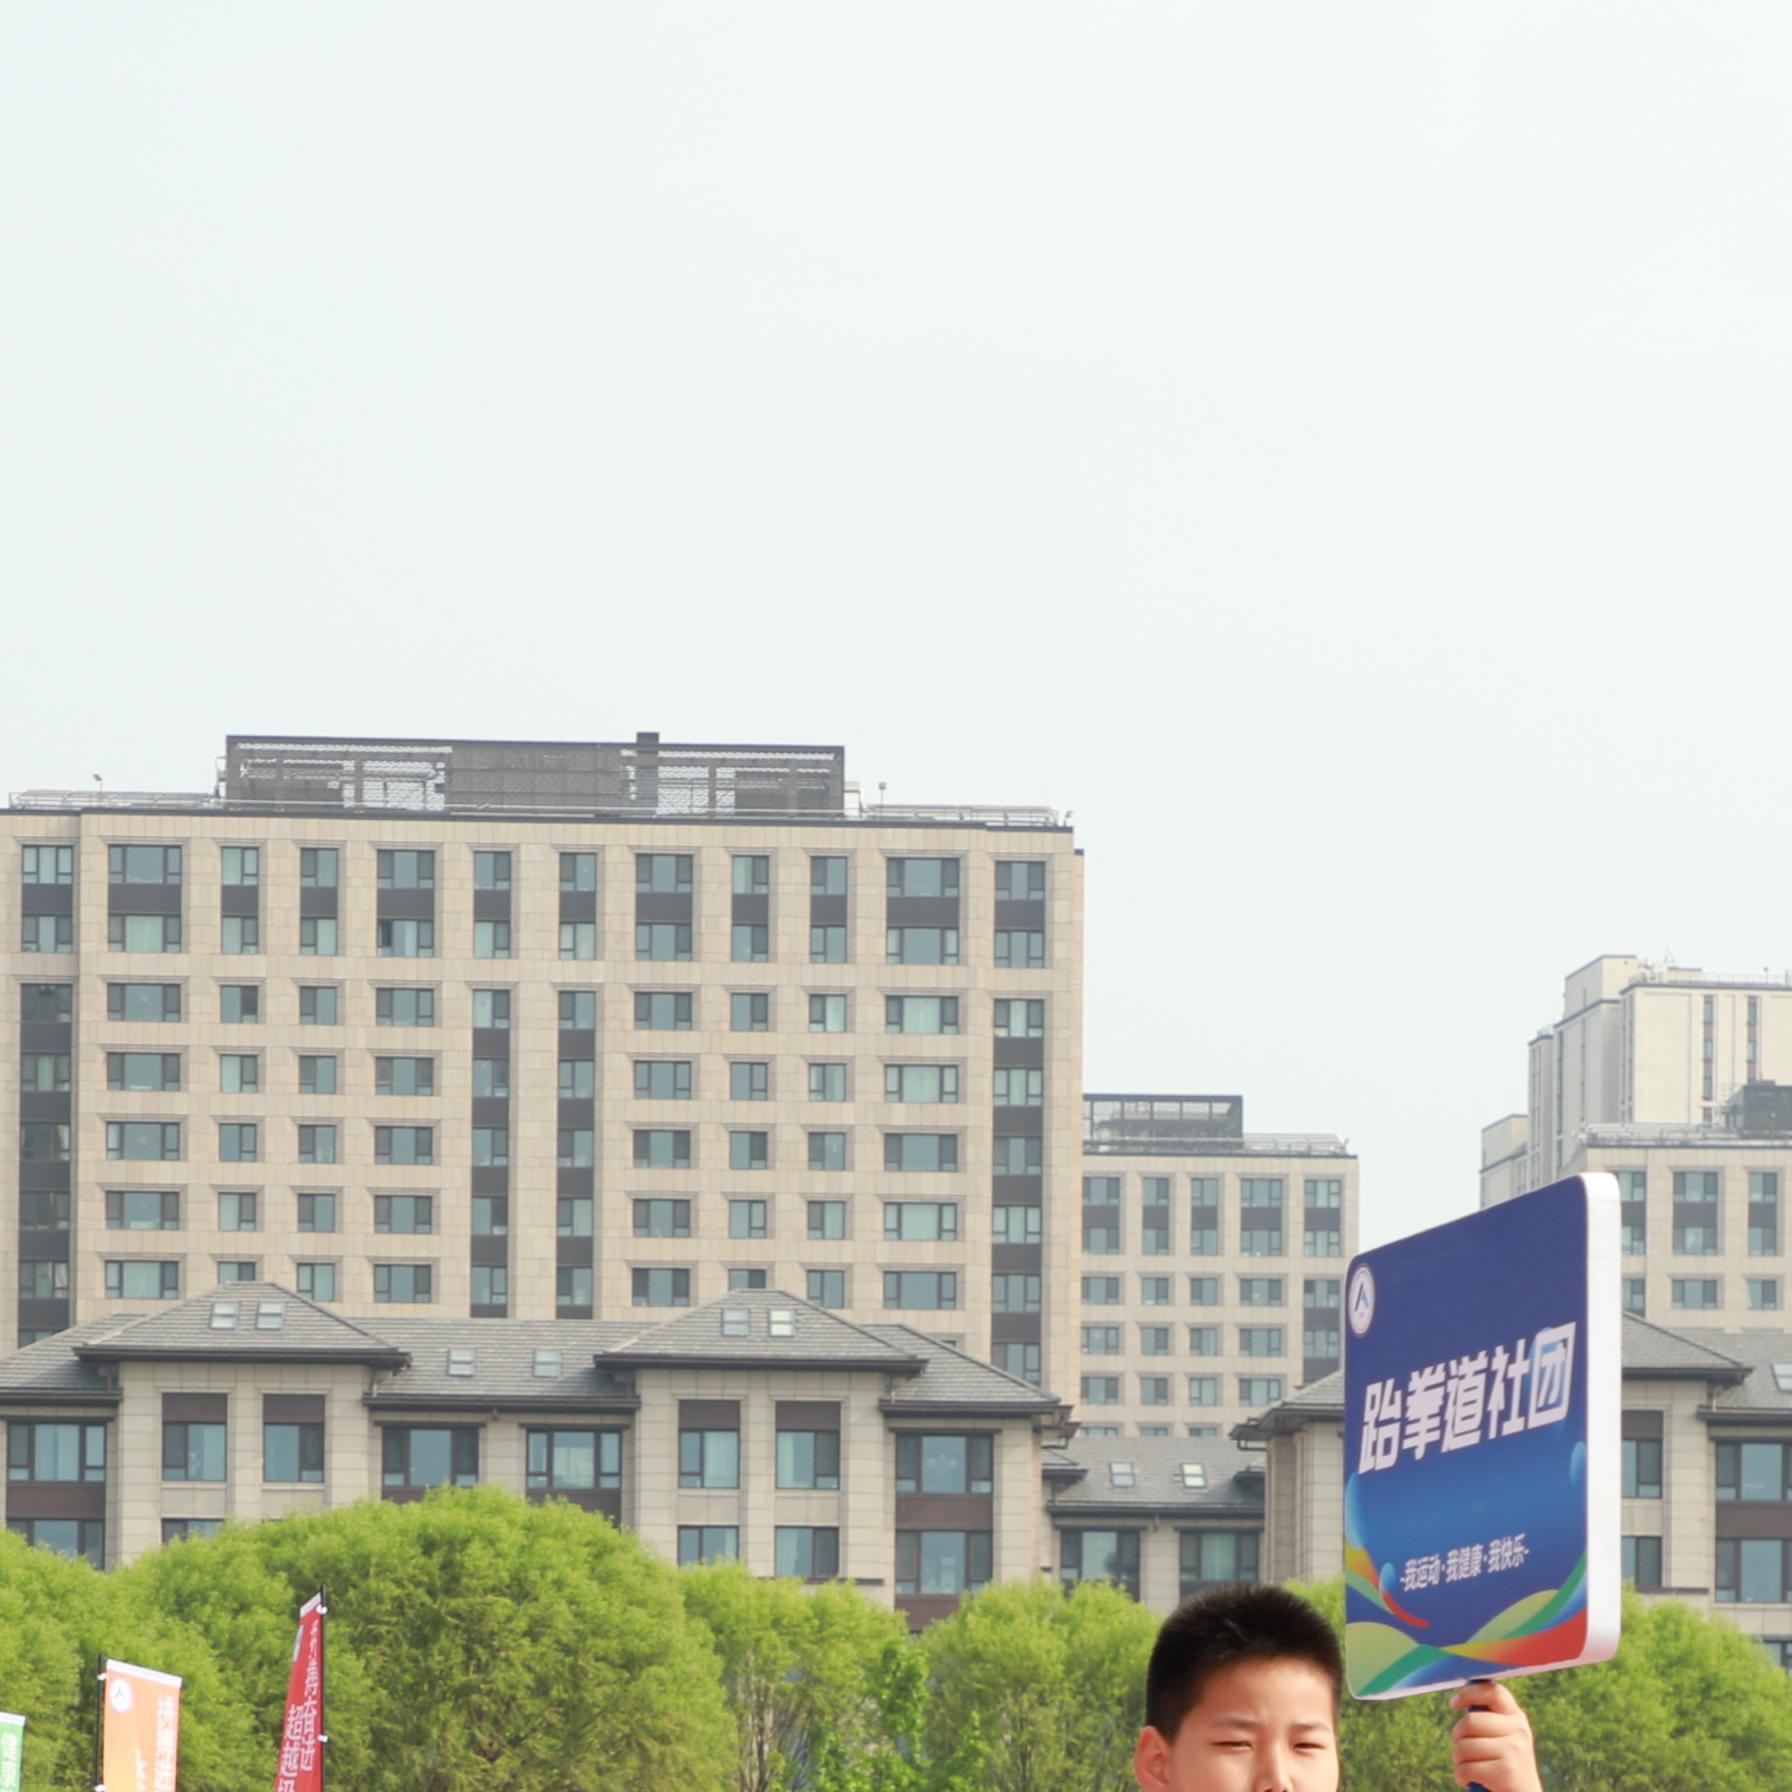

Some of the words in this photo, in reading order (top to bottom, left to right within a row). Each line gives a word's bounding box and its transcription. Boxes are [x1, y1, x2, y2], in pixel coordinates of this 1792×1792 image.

[1358, 1321, 1576, 1474] 跆拳道社团
